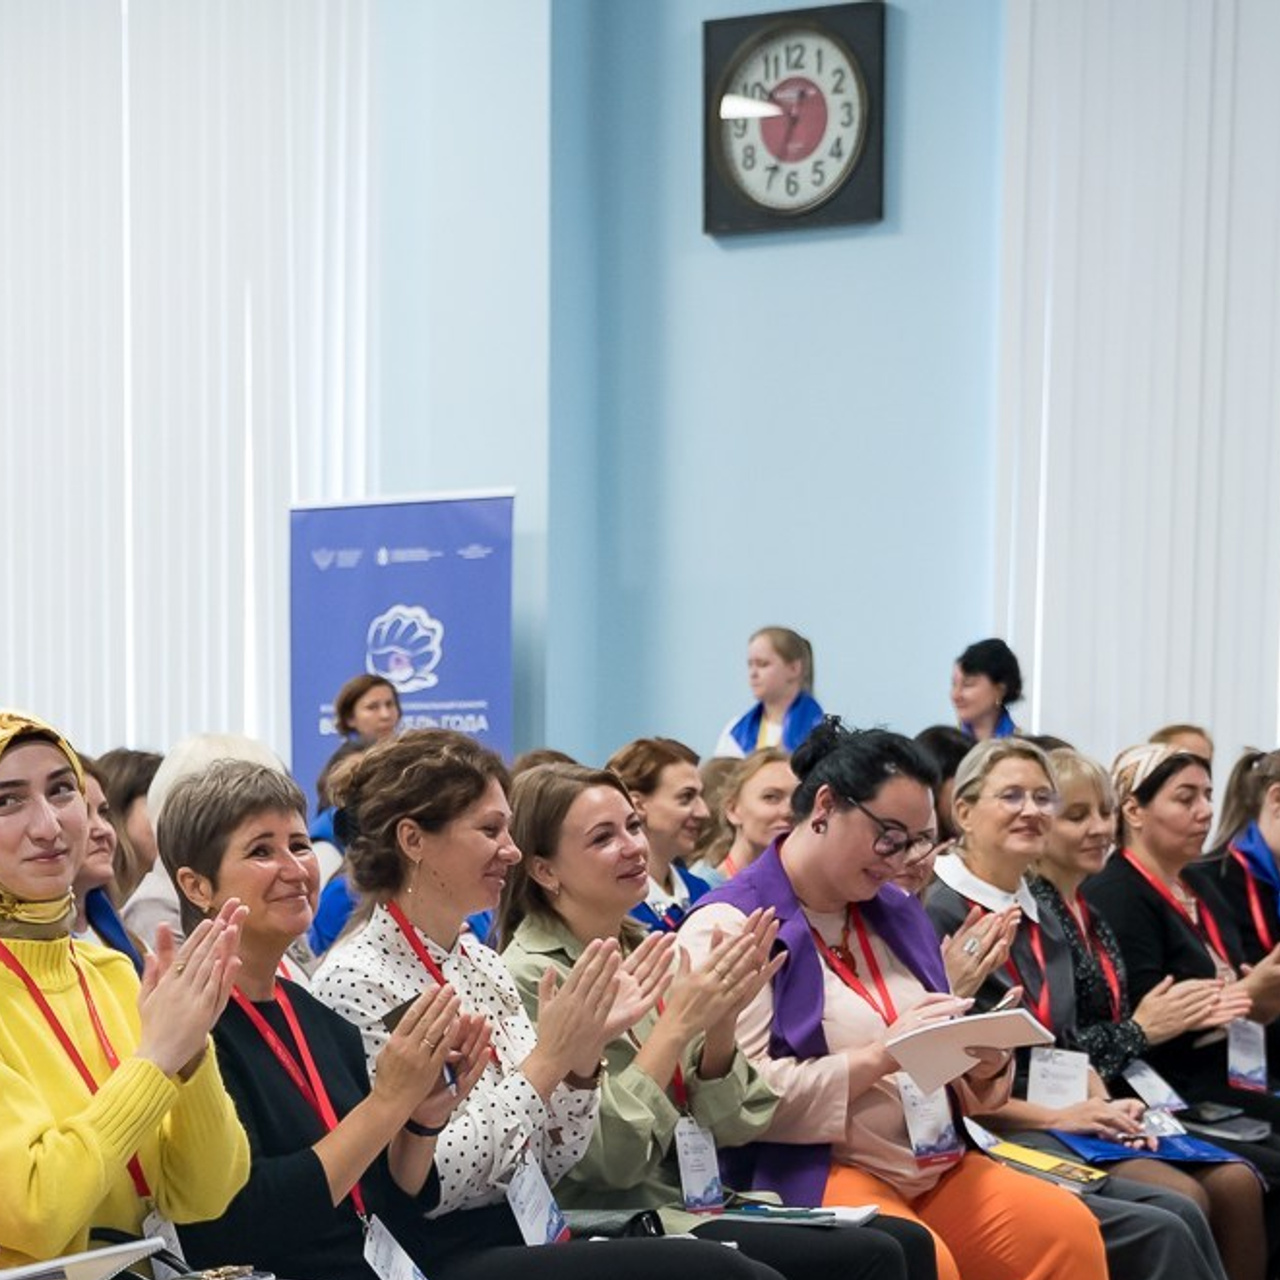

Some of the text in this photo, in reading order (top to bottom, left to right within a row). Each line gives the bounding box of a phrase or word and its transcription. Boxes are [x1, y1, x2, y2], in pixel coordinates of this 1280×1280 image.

[765, 54, 779, 80] 11
[785, 44, 805, 70] 12
[816, 48, 822, 74] 1
[832, 69, 845, 94] 2
[841, 102, 854, 127] 3
[742, 145, 756, 171] 8
[829, 138, 843, 162] 4
[765, 165, 780, 191] 7
[785, 171, 800, 197] 6
[811, 161, 825, 187] 5
